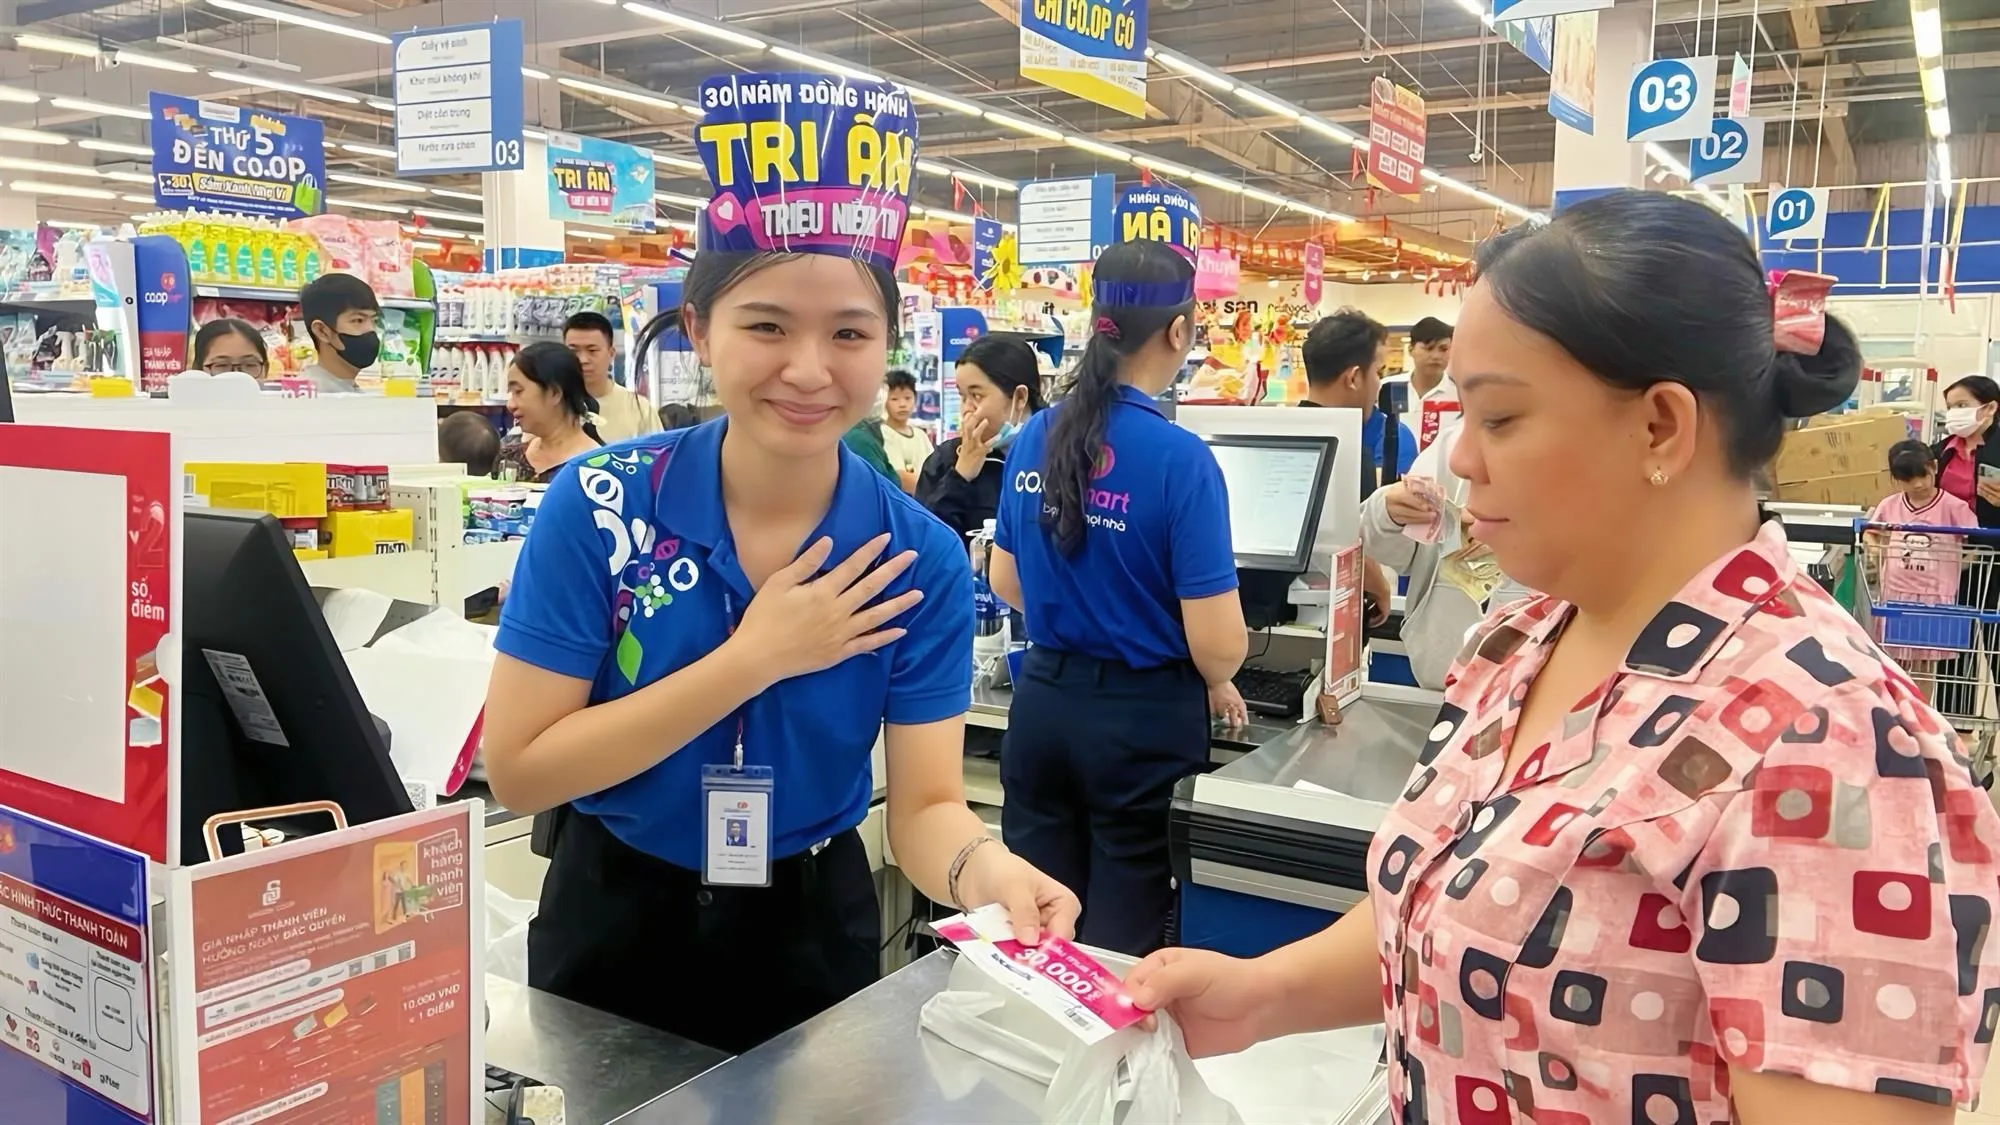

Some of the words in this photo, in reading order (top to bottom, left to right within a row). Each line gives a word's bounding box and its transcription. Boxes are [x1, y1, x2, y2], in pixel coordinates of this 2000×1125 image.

[1065, 0, 1112, 41] CO.OP
[1114, 10, 1135, 50] CÓ
[704, 86, 734, 108] 30
[741, 79, 792, 105] NĂM
[799, 78, 858, 108] ĐỒNG
[864, 85, 908, 118] HÀNH
[1638, 73, 1692, 113] 03
[209, 125, 251, 151] THỨ
[254, 124, 275, 156] 5
[494, 139, 520, 166] 03
[700, 120, 820, 187] TRI
[846, 112, 915, 196] ÂN
[1699, 131, 1743, 161] 02
[172, 138, 225, 172] ĐẾN
[232, 155, 307, 182] CO.OP
[553, 166, 582, 189] TRI
[587, 166, 611, 191] ÂN
[761, 199, 824, 239] TRIỆU
[1778, 198, 1807, 222] 01
[131, 575, 149, 598] số
[130, 595, 166, 623] điểm
[64, 911, 98, 937] THANH
[201, 939, 223, 953] GIA
[302, 906, 328, 923] VIÊN
[1014, 948, 1094, 995] 30.000
